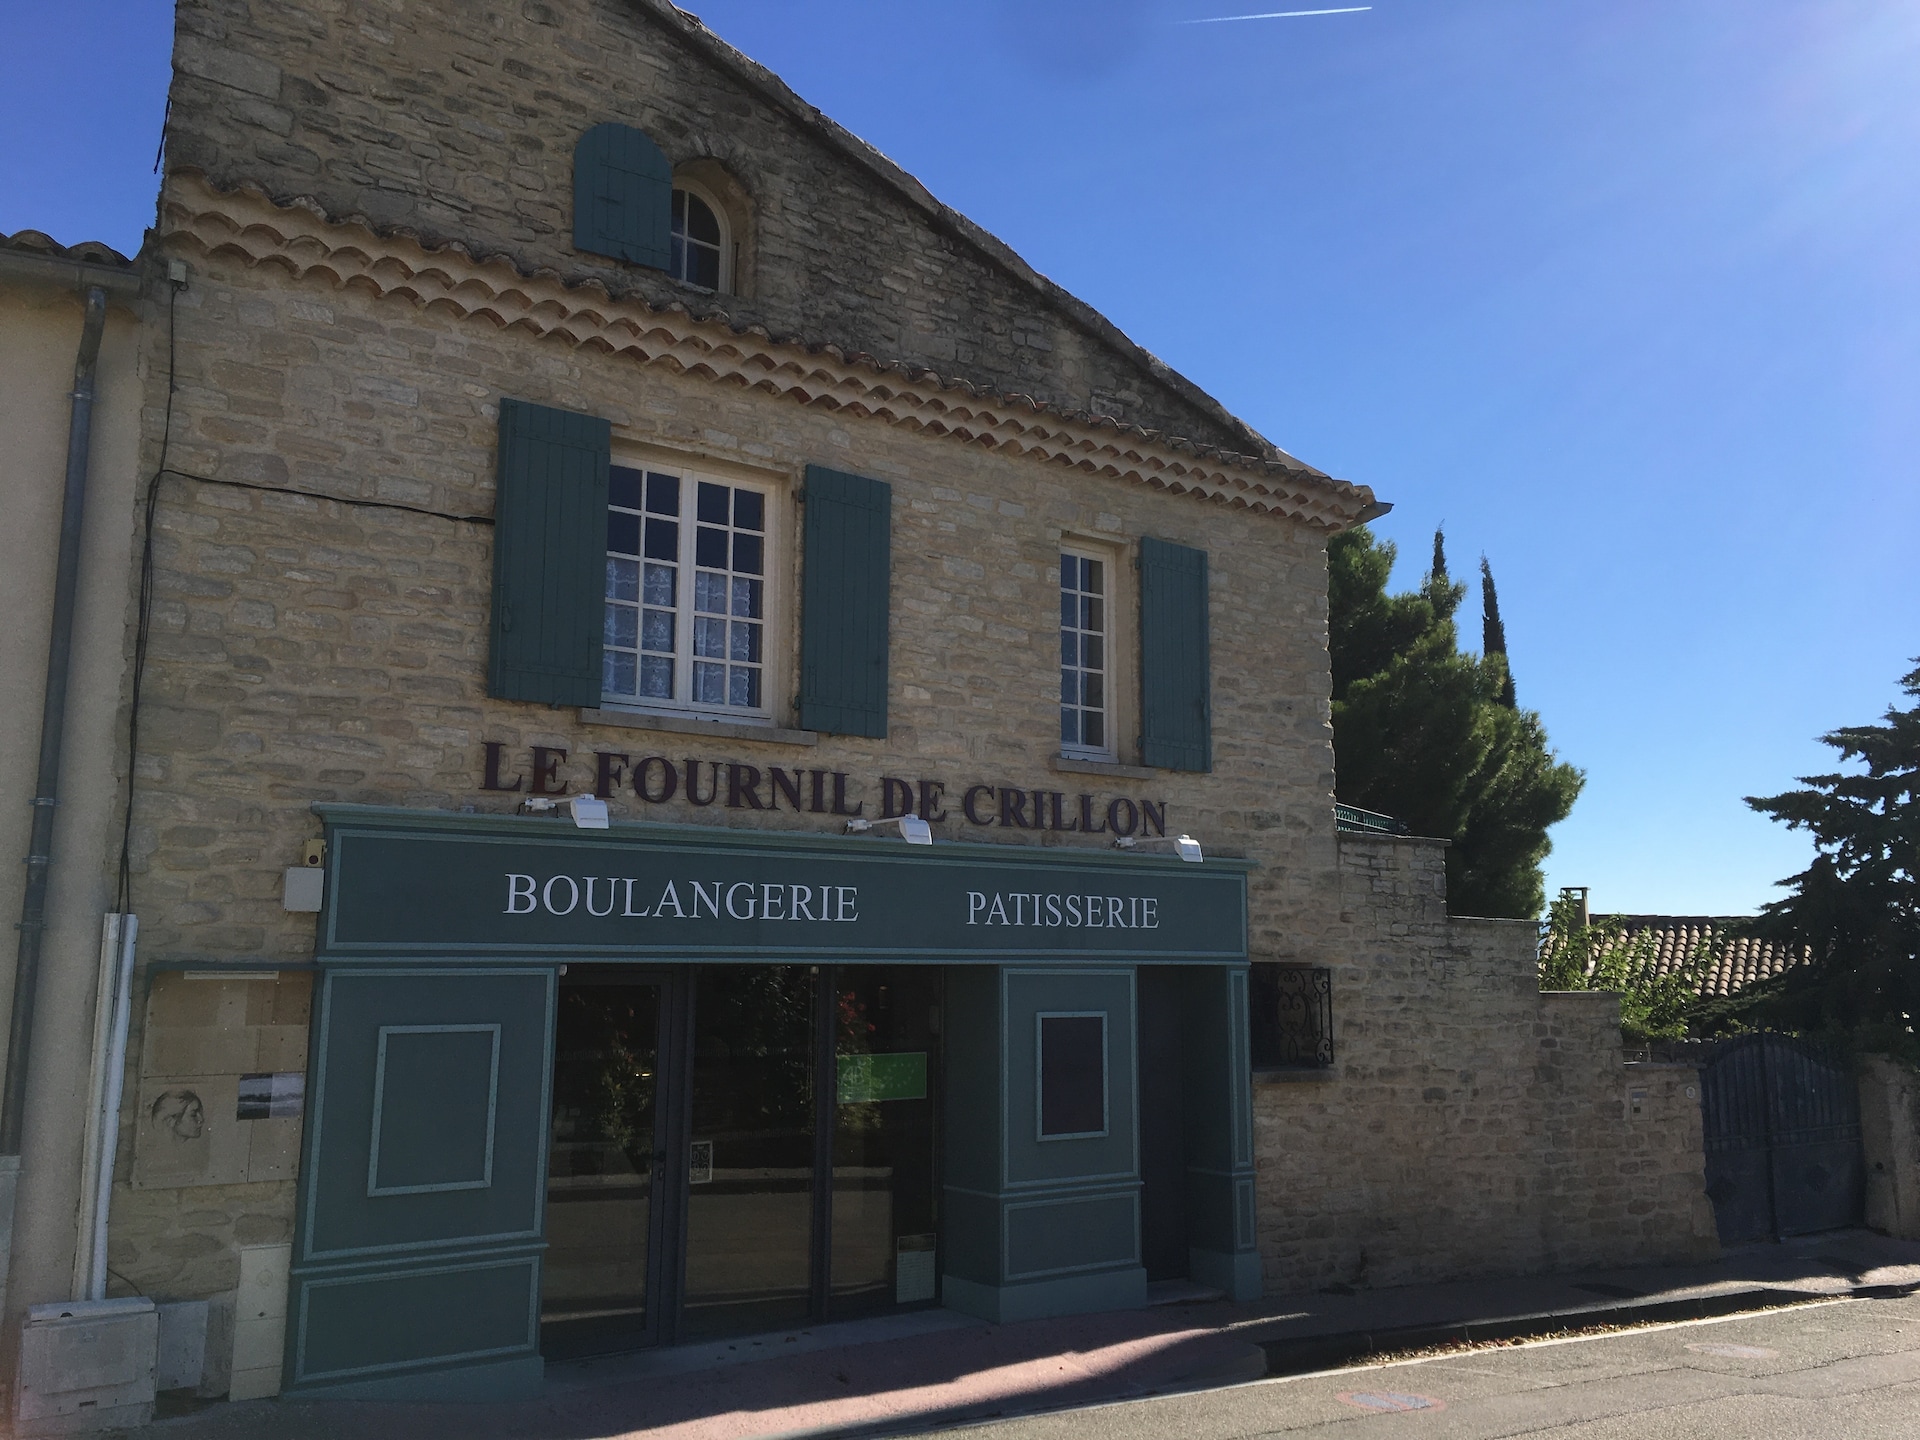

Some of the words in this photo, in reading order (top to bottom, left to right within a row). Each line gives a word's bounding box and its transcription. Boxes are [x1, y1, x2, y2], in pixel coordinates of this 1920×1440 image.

[479, 742, 568, 794] LE
[593, 751, 863, 816] FOURNIL
[880, 776, 947, 823] DE
[963, 785, 1168, 838] CRILLON
[502, 873, 860, 923] BOULANGERIE
[966, 891, 1160, 929] PATISSERIE
